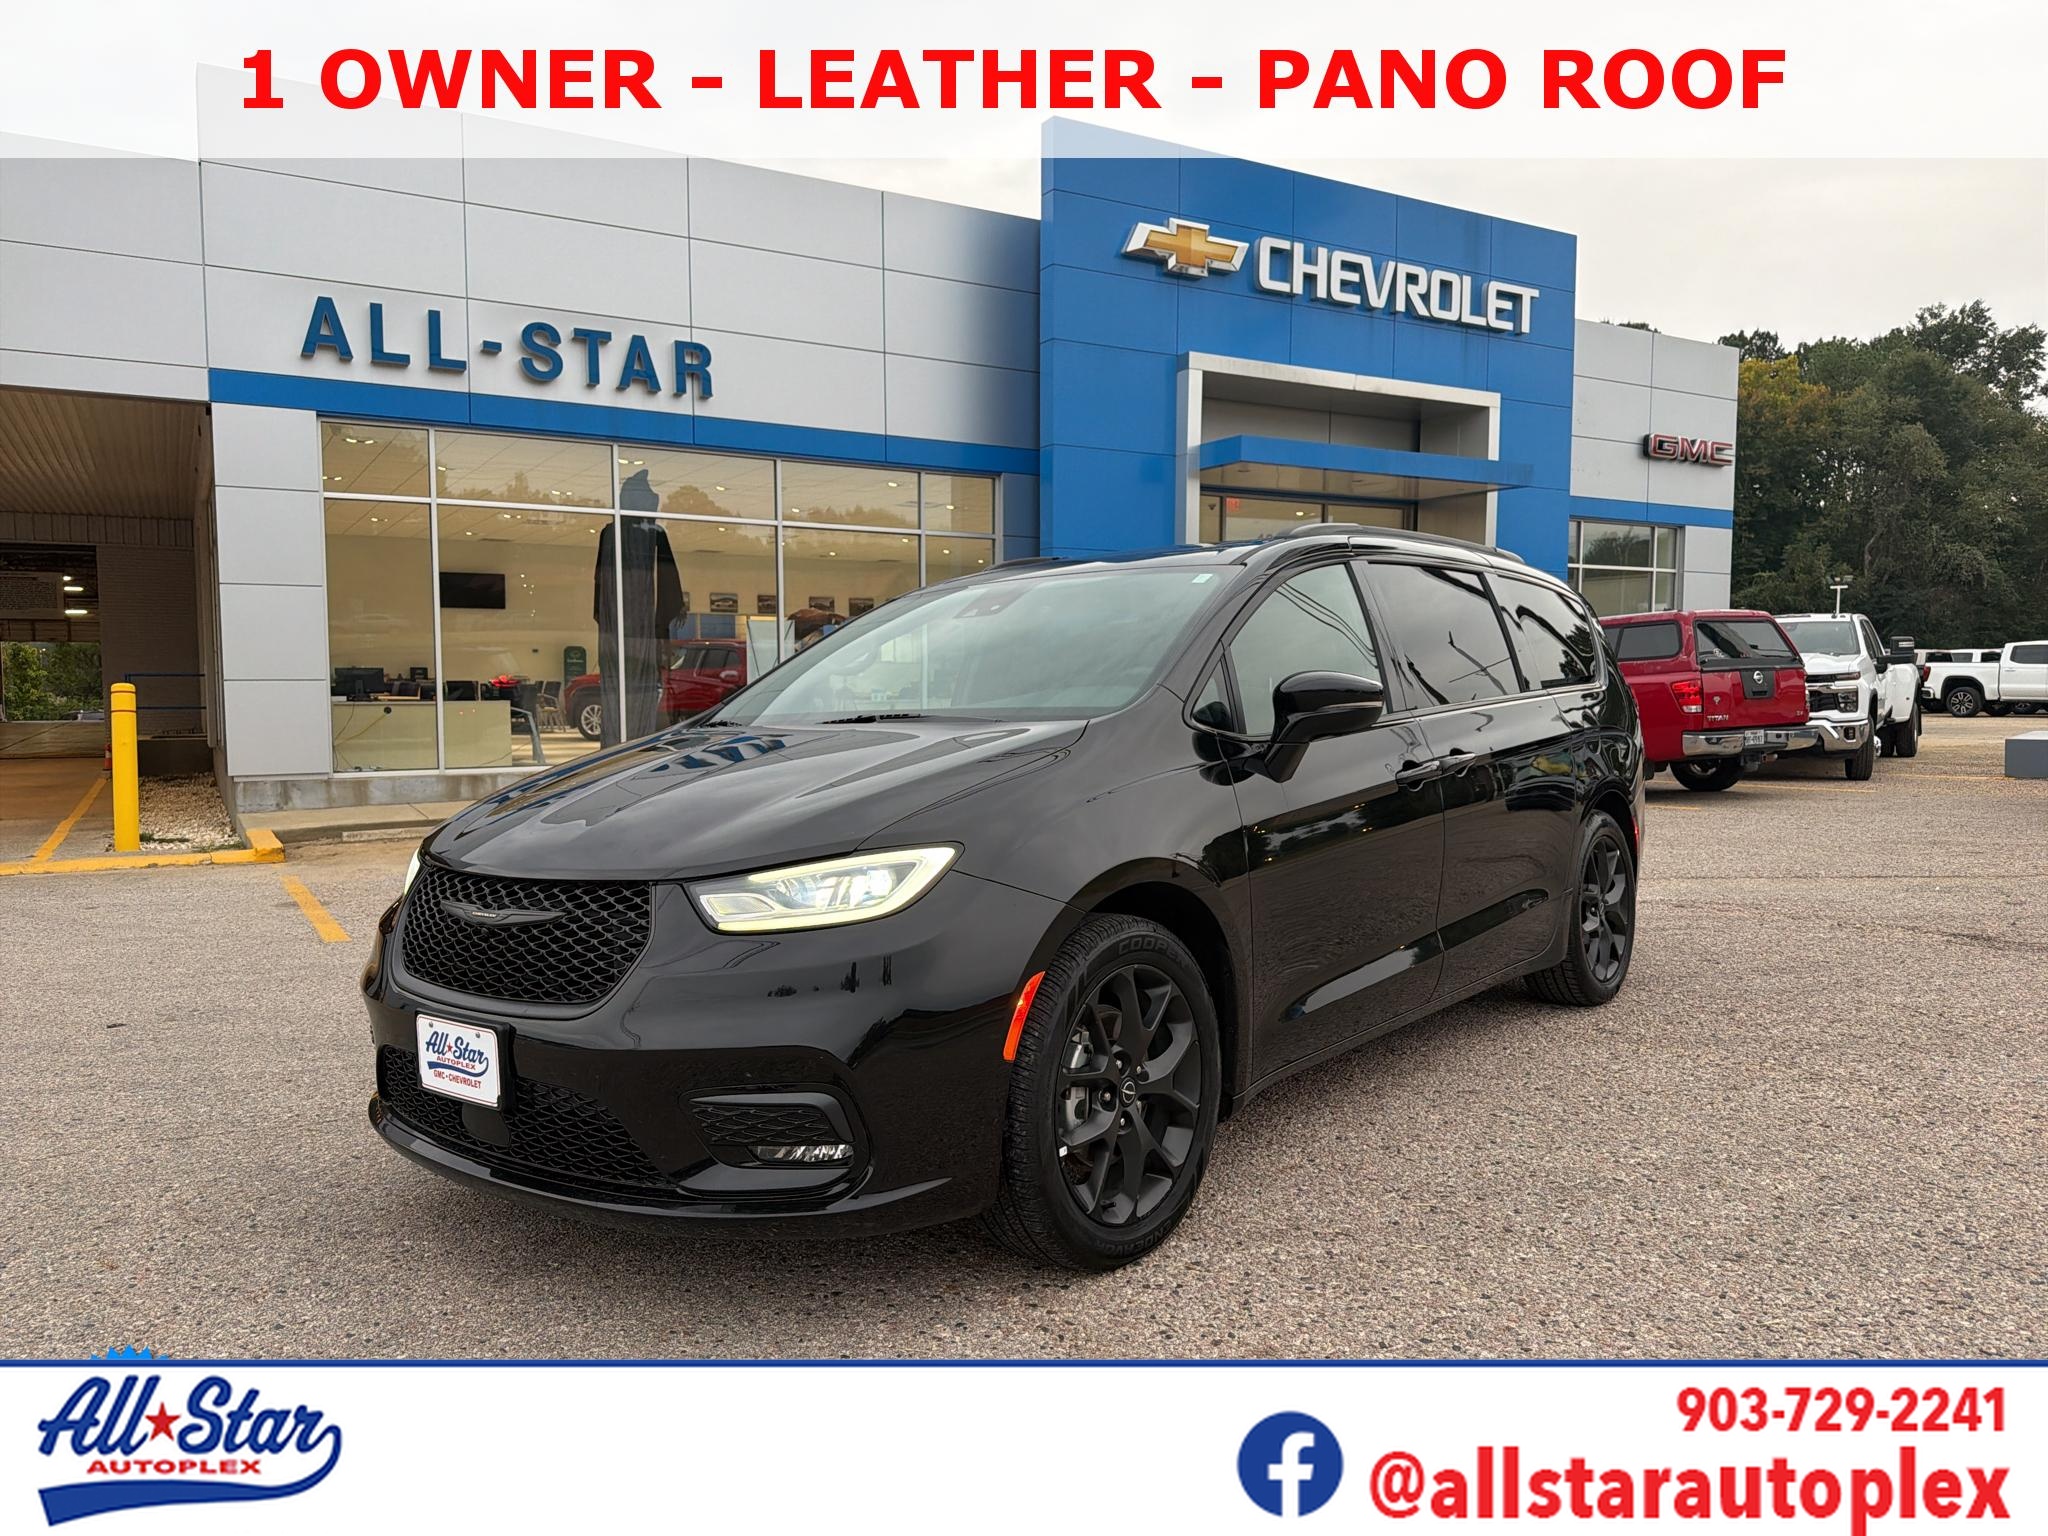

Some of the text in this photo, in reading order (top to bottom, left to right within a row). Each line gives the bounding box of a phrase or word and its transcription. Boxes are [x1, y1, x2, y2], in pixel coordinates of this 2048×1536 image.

[1257, 235, 1541, 335] CHEVROLET
[301, 295, 714, 399] ALL-STAR
[1648, 433, 1734, 466] GMC
[1706, 714, 1729, 722] TITAN
[425, 1030, 486, 1066] All Star
[436, 1055, 476, 1071] AUTOPLEX
[433, 1069, 482, 1090] GMC CHEVROLET
